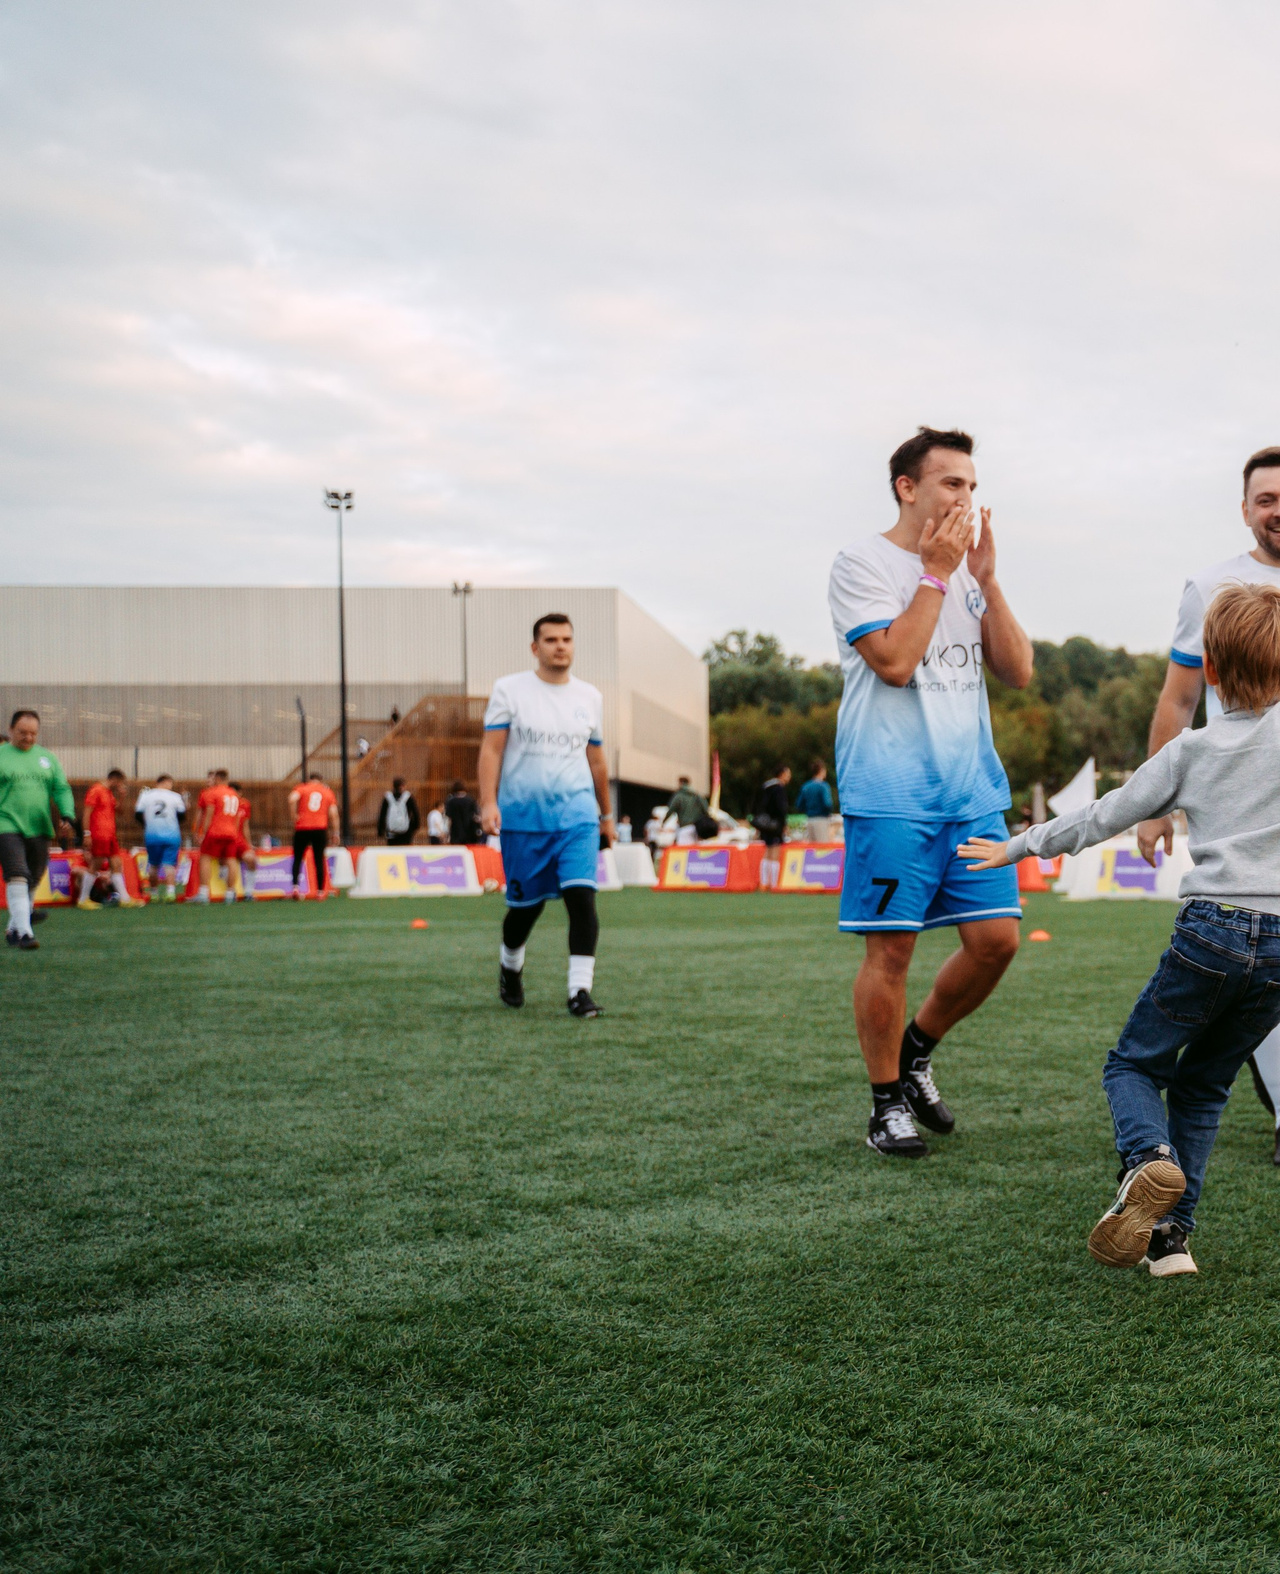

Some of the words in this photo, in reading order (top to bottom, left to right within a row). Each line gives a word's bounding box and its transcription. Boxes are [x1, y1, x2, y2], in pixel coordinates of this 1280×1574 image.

[923, 643, 983, 676] икор
[510, 879, 524, 900] 3
[871, 877, 899, 915] 7
